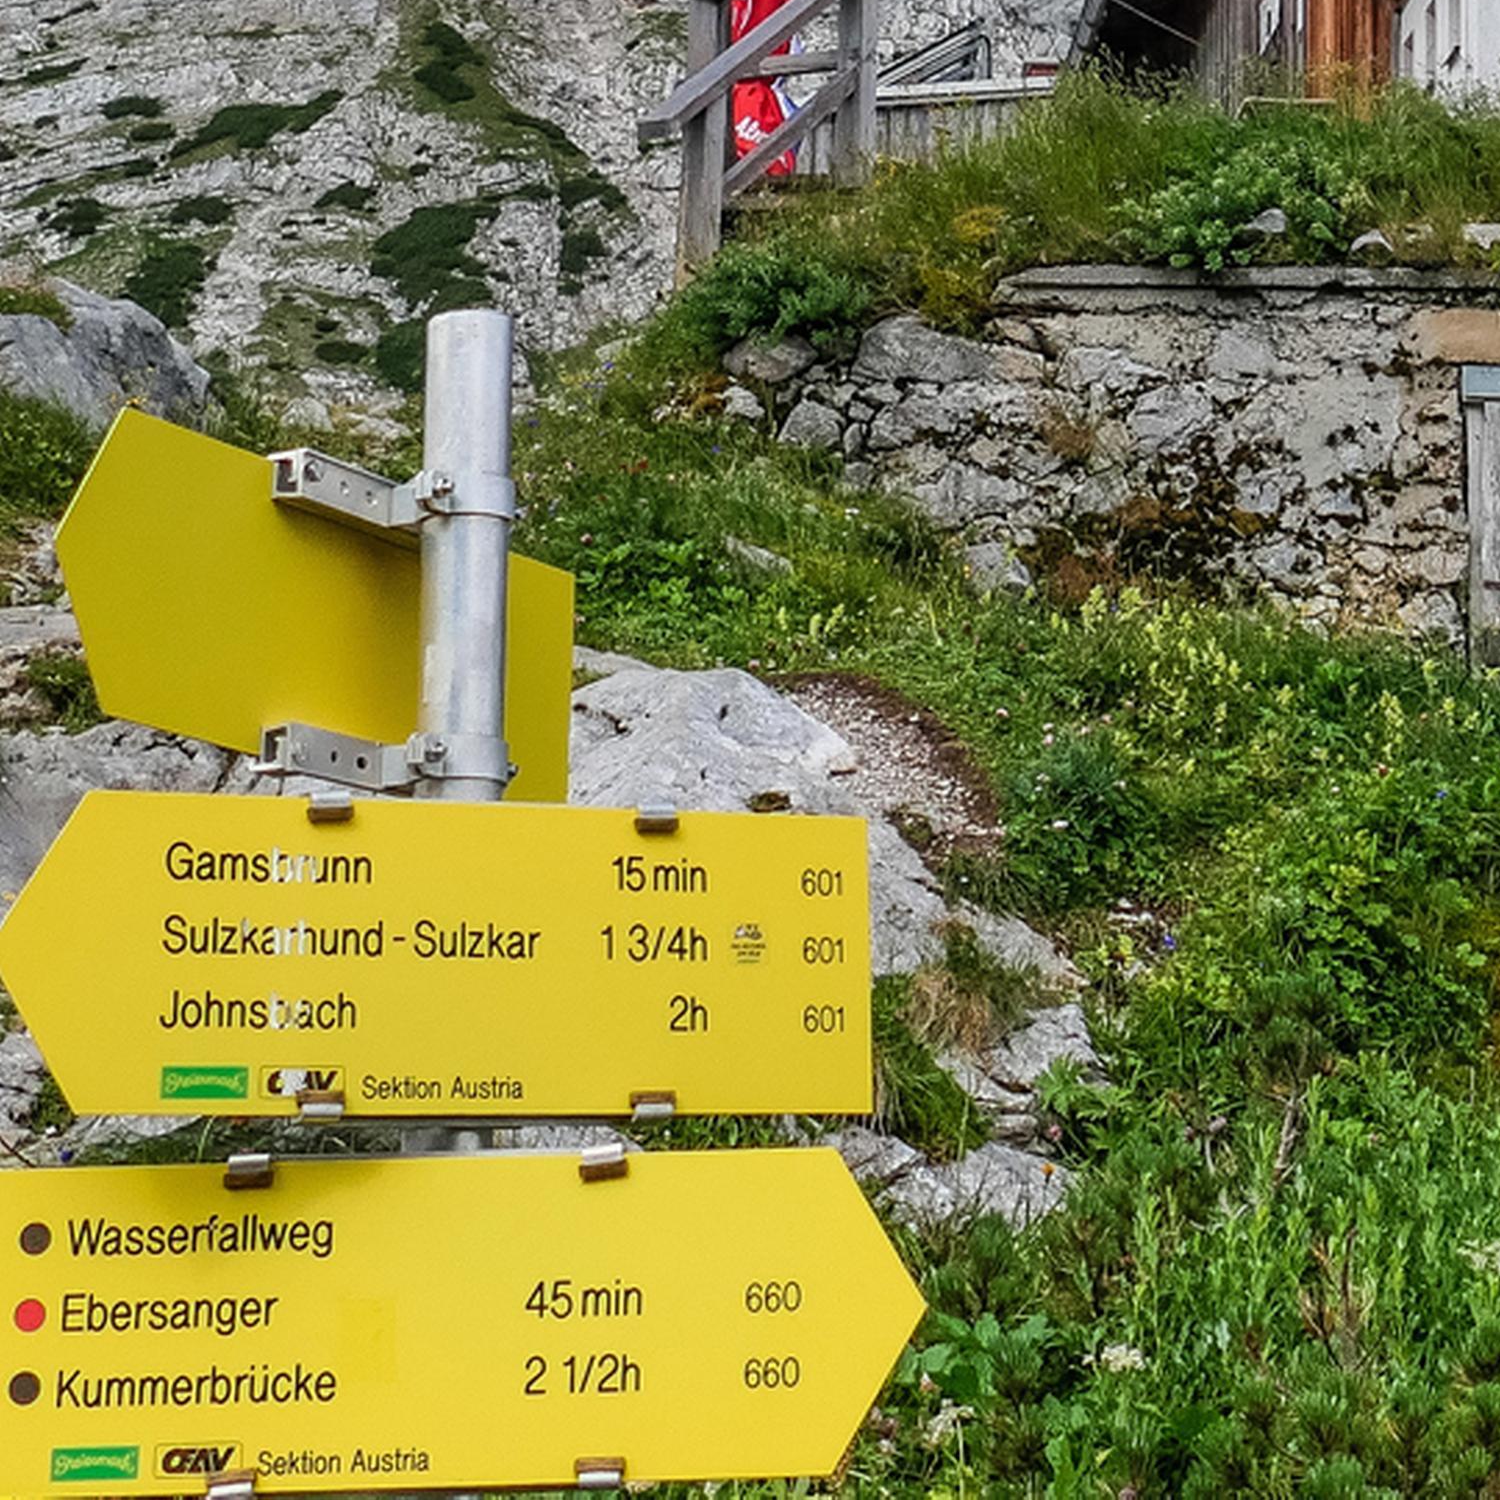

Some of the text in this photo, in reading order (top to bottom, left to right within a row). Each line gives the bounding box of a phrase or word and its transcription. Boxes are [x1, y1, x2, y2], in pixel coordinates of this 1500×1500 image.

[166, 841, 842, 896] Gamsbrunn 15 min 601
[414, 919, 541, 959] Sulzkar
[803, 936, 844, 964] 601
[159, 990, 844, 1033] Johnsbach 2h 601
[362, 1076, 442, 1099] Sektion
[451, 1076, 523, 1099] Austria
[68, 1214, 334, 1258] Wasserfallweg
[61, 1279, 801, 1336] Ebersanger 45 min 660
[56, 1363, 337, 1408] Kummerbrücke
[744, 1357, 800, 1389] 660
[257, 1451, 341, 1477] Sektion
[350, 1448, 430, 1474] Austria
